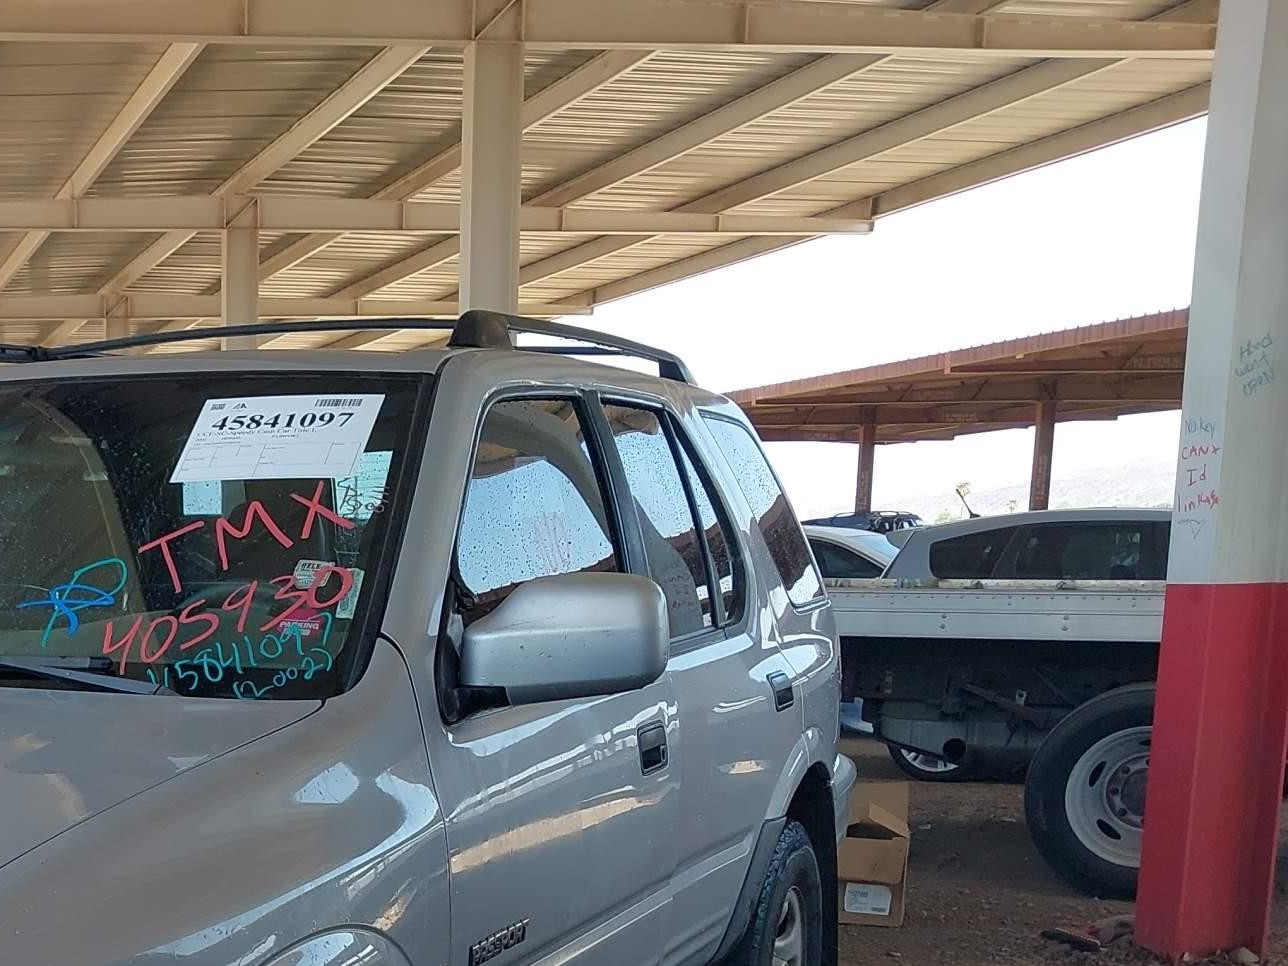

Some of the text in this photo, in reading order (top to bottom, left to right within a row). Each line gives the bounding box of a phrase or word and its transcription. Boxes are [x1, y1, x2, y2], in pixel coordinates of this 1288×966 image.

[211, 413, 354, 431] 45841097
[137, 480, 355, 594] TMX
[103, 565, 353, 675] 405930
